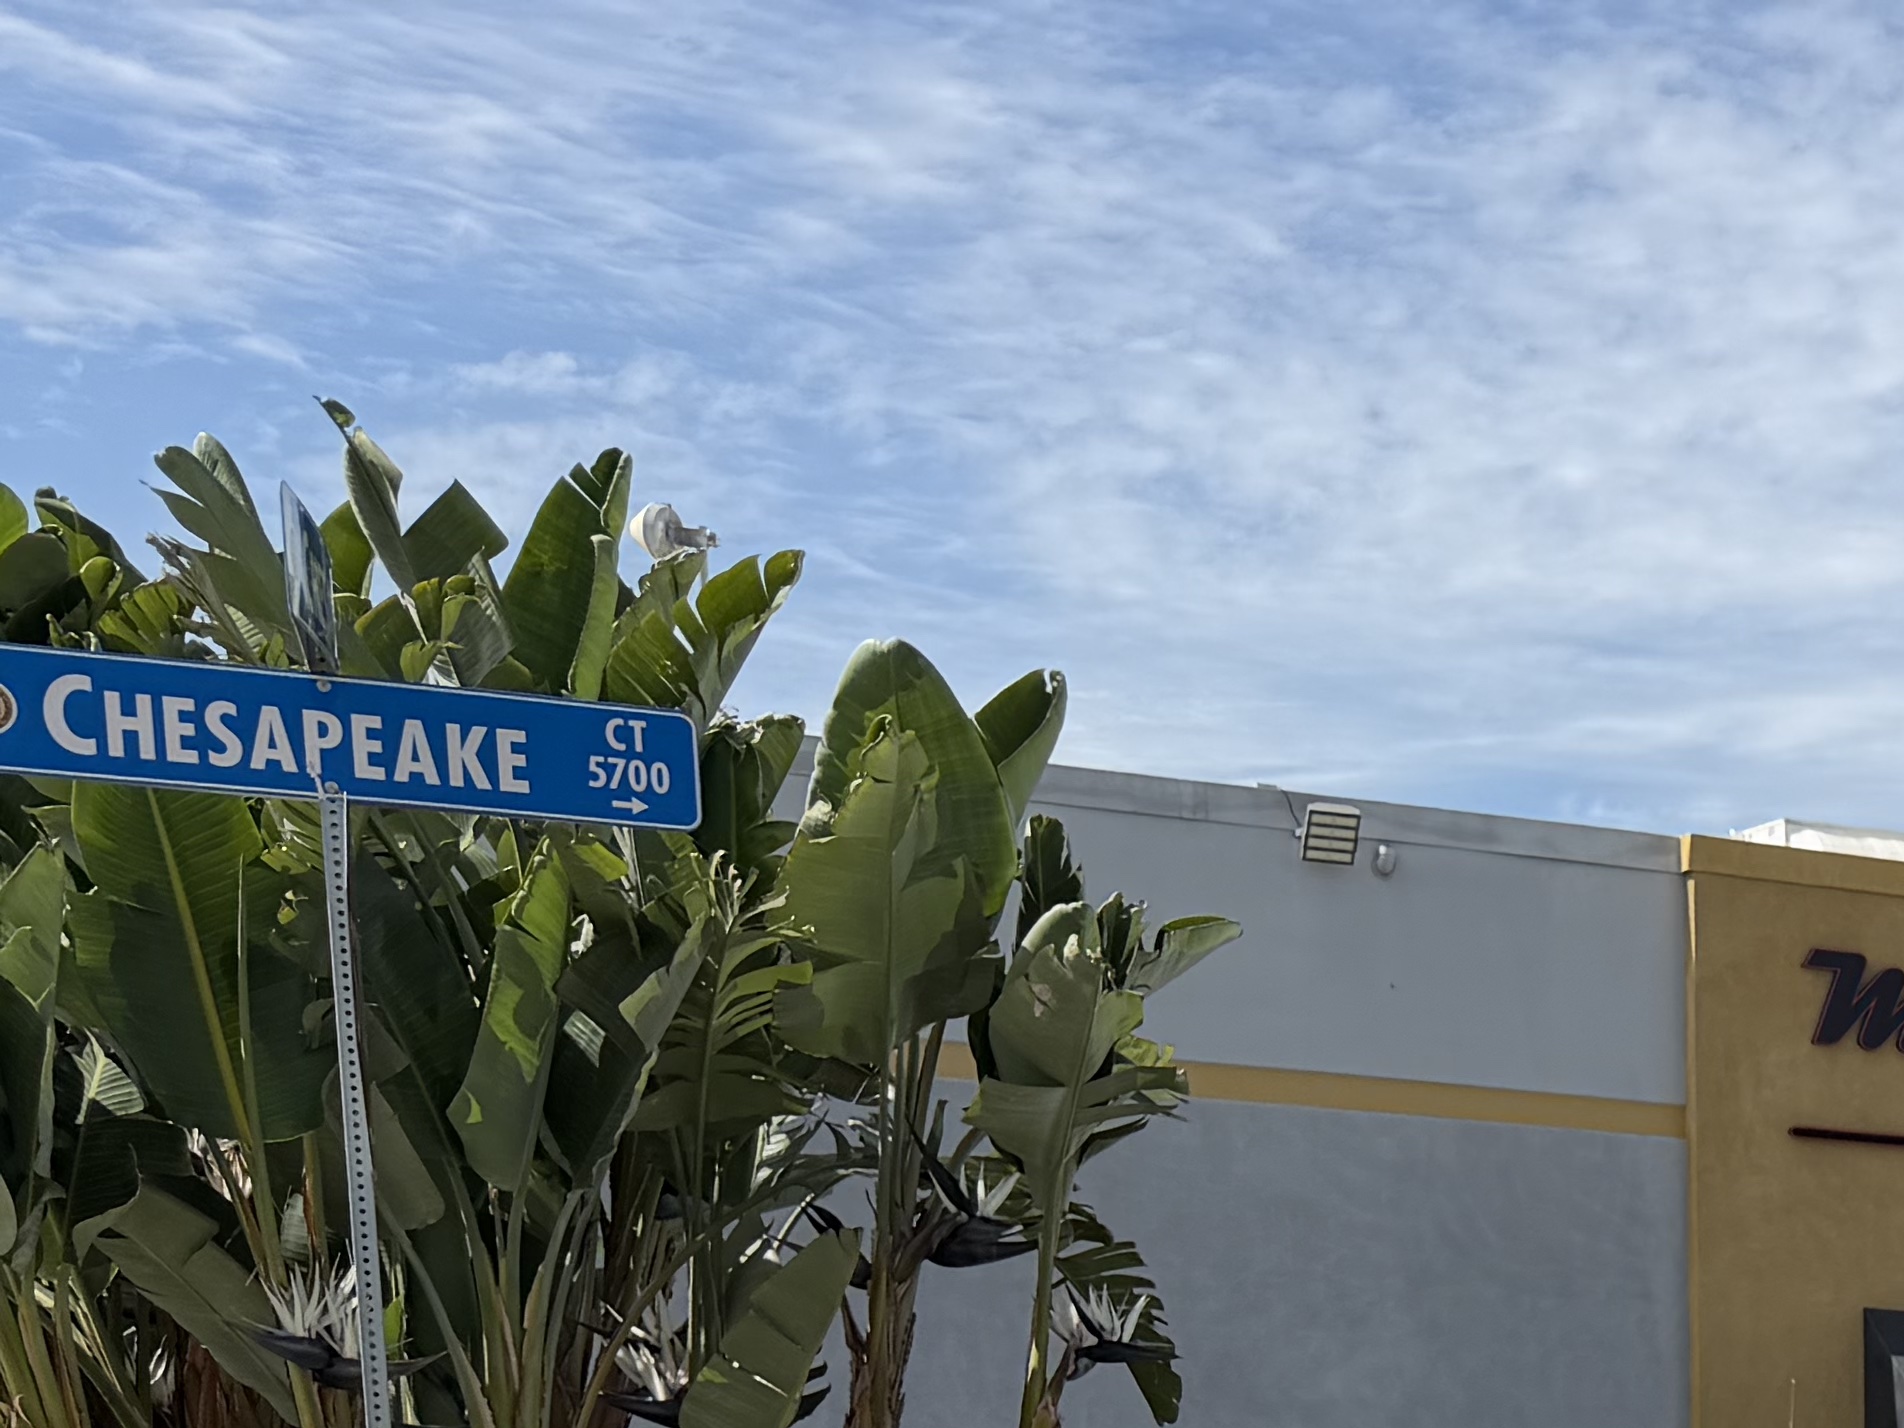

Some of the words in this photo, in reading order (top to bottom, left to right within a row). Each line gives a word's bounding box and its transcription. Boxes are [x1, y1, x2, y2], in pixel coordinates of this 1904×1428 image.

[43, 673, 531, 794] CHESAPEAKE
[604, 717, 647, 753] CT
[588, 754, 670, 795] 5700
